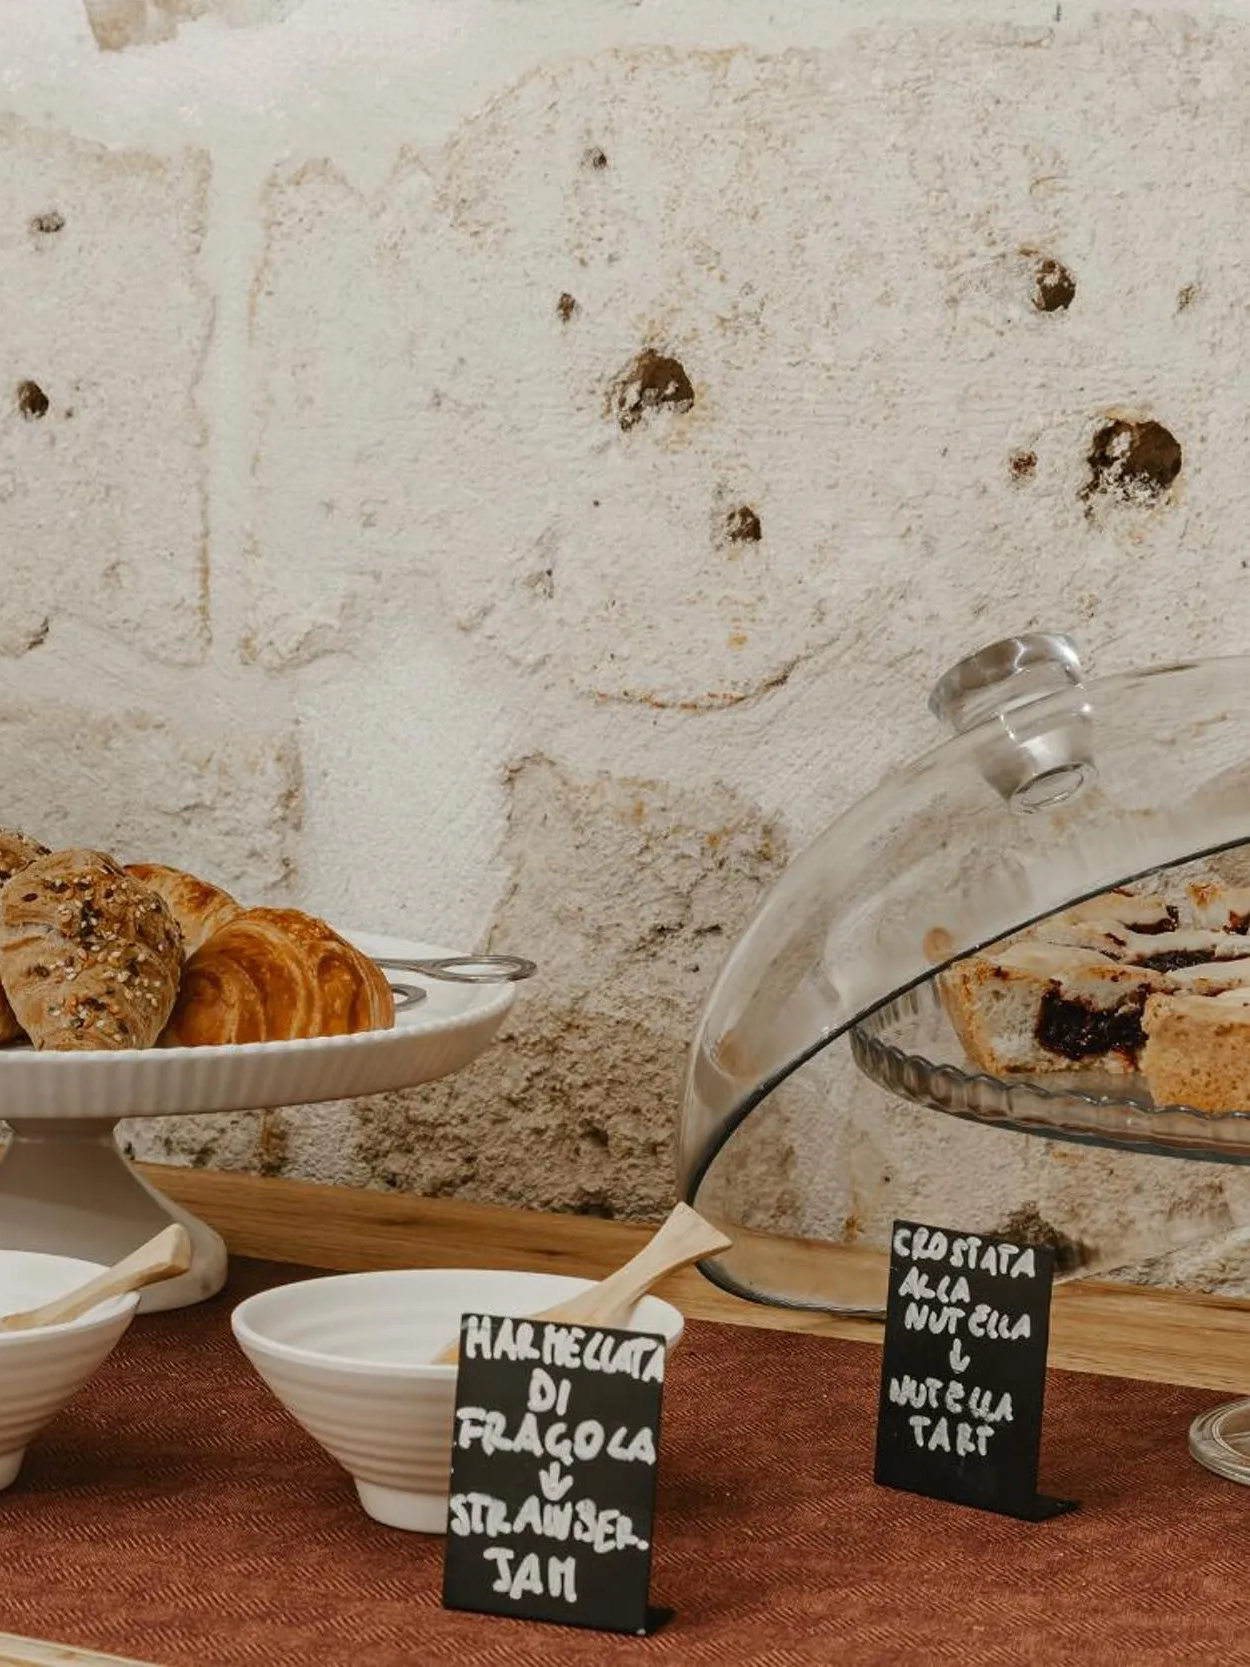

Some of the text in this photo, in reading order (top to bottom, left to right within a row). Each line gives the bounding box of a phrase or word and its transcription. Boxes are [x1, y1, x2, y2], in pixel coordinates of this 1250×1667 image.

[893, 1227, 1036, 1279] CROSTATA
[898, 1265, 971, 1303] ALLA
[904, 1302, 1031, 1339] NUTELLA
[465, 1315, 666, 1383] MARMELLATA
[527, 1367, 572, 1416] DI
[889, 1375, 1014, 1422] NUTELLA
[456, 1406, 657, 1466] FRAGOLA
[909, 1415, 995, 1457] TART
[483, 1547, 578, 1603] JAM
